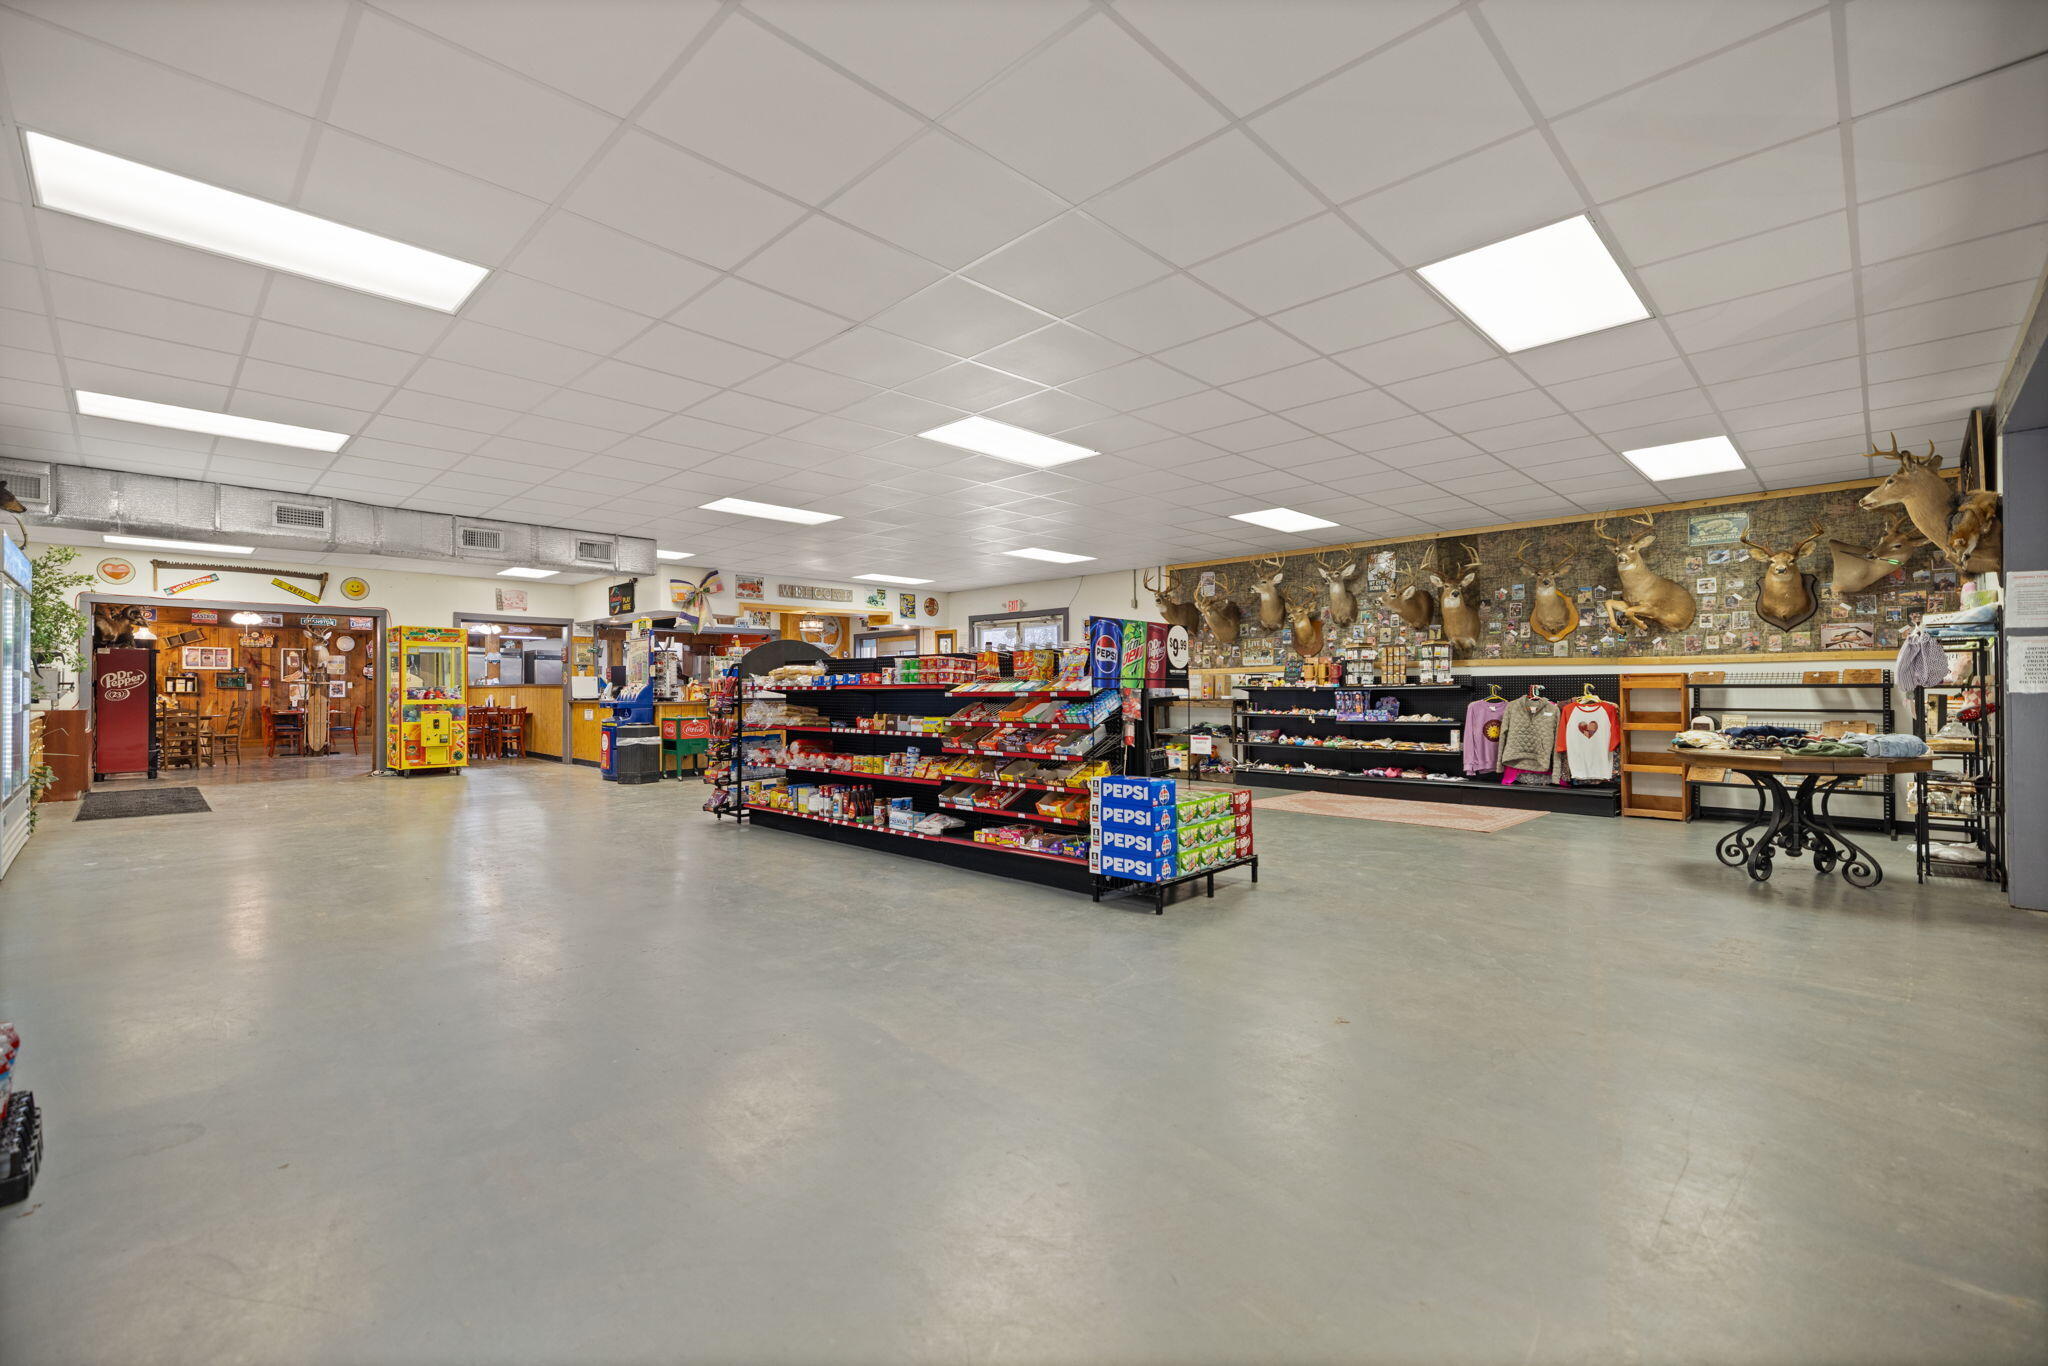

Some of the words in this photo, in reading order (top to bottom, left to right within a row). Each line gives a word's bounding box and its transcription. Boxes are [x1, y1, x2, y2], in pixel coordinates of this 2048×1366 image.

[781, 585, 852, 601] WELCOME
[1008, 600, 1019, 612] EXIT
[1096, 649, 1117, 661] PEPSI
[105, 673, 143, 688] Pepper
[116, 671, 133, 680] Dr
[1102, 782, 1149, 801] PEPSI
[1102, 807, 1151, 826] PEPSI
[1103, 831, 1152, 852] PEPSI
[1102, 855, 1152, 877] PEPSI
